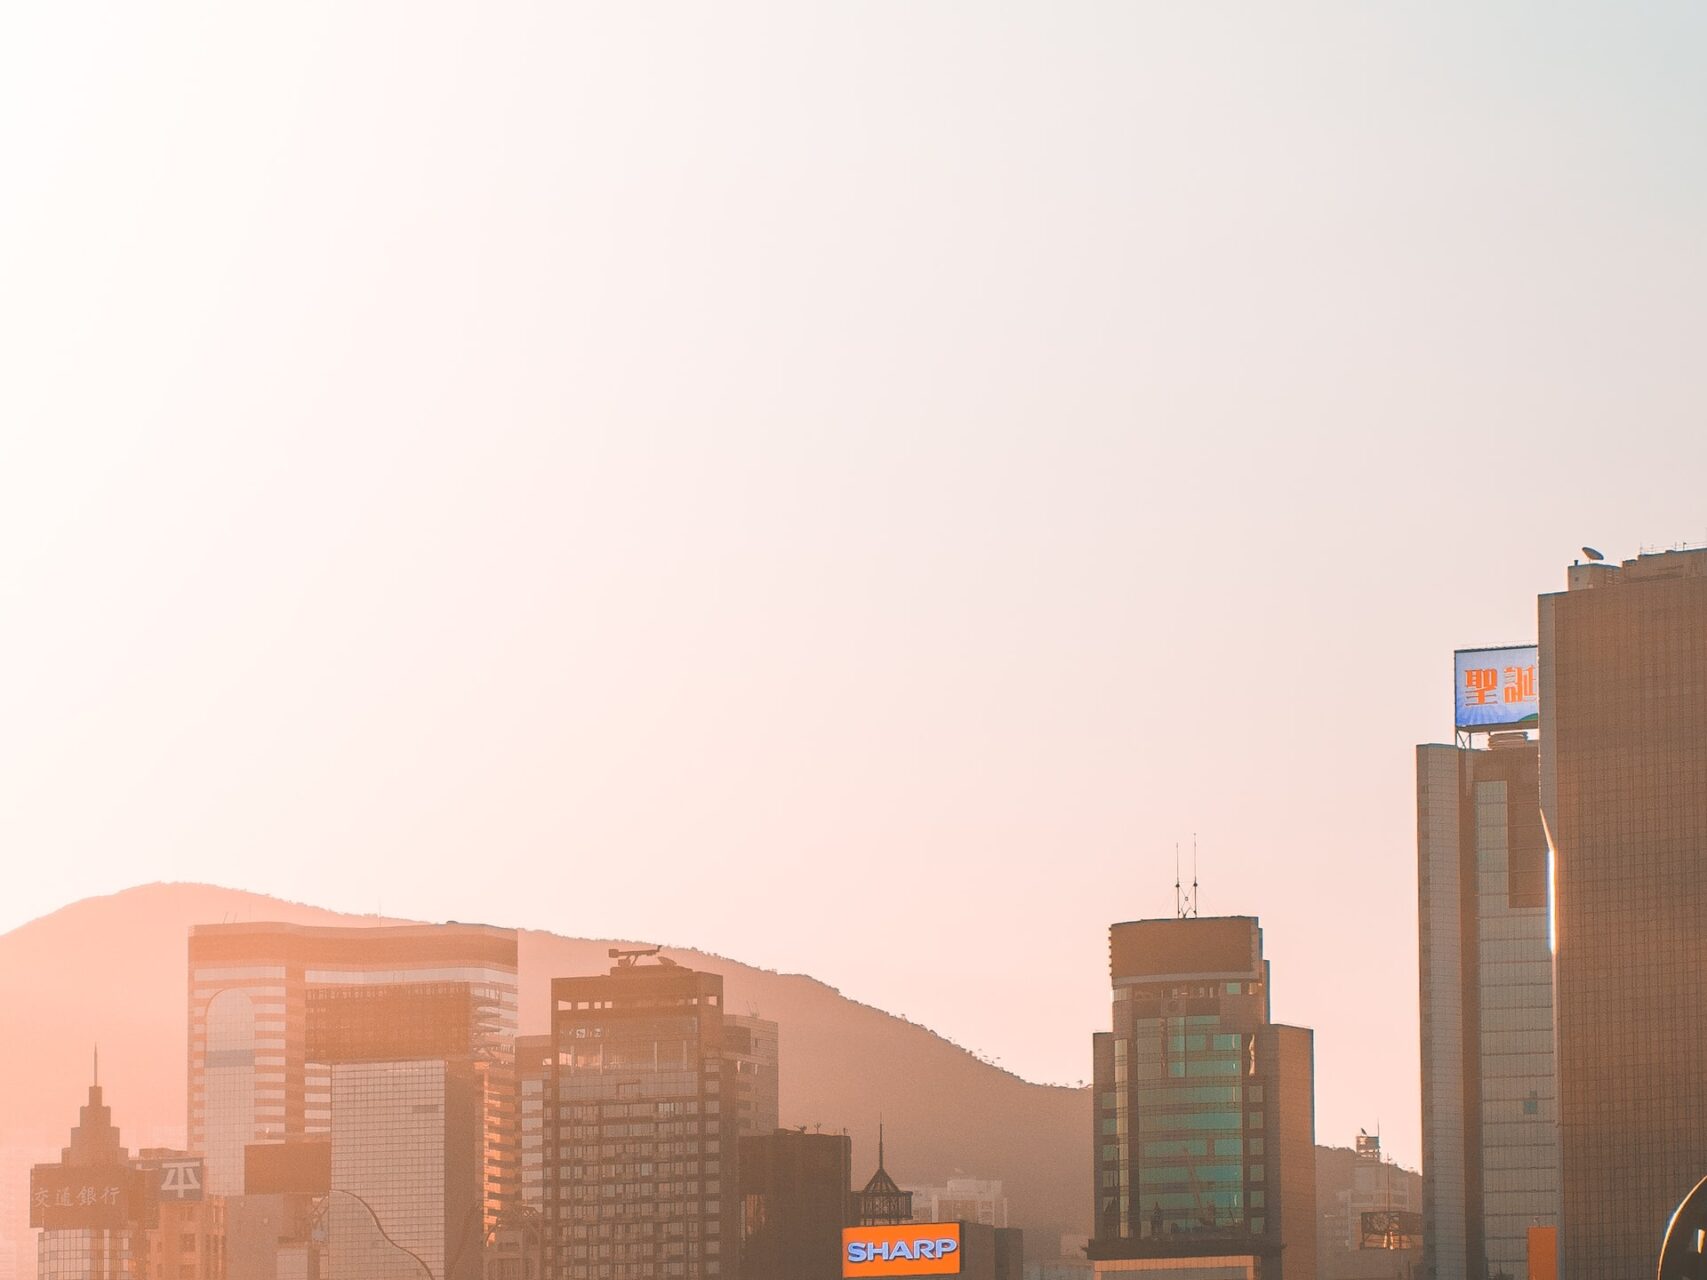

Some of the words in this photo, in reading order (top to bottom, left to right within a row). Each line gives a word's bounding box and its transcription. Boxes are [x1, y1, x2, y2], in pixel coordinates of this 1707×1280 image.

[1464, 665, 1538, 706] 聖誕
[32, 1186, 120, 1207] 交通銀行
[847, 1238, 958, 1263] SHARP
